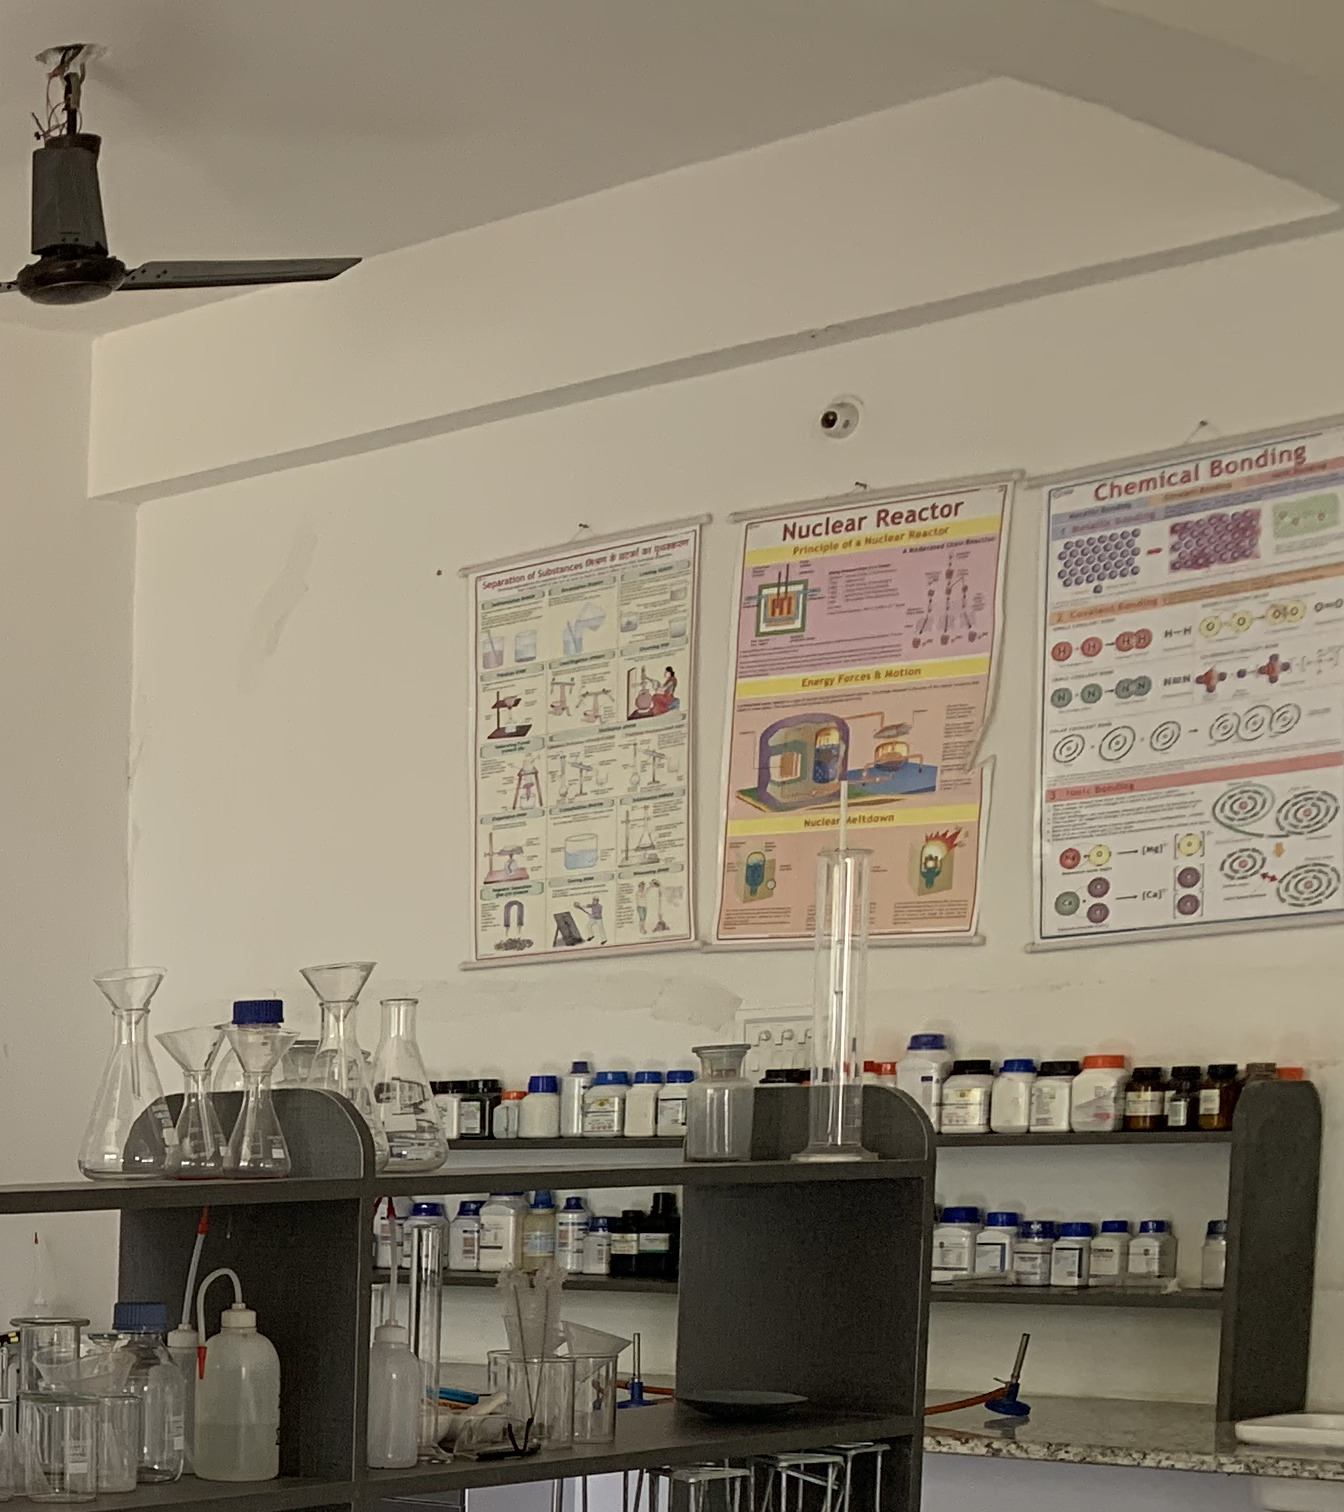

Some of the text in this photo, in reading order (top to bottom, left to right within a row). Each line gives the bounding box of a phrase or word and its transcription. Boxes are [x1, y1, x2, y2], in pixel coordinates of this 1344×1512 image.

[1094, 445, 1306, 501] Chemical Bonding
[1101, 502, 1131, 514] Bonding
[783, 501, 964, 541] Nuclear Reactor
[793, 540, 840, 555] Principle
[842, 538, 853, 550] of
[865, 532, 904, 545] Nuclear
[909, 526, 950, 539] Reactor
[909, 543, 944, 553] Moderated
[966, 536, 996, 545] Reaction
[483, 575, 525, 590] Separation
[527, 570, 535, 580] of
[537, 562, 583, 578] Substances
[1118, 598, 1157, 611] Bonding
[801, 676, 835, 689] Energy
[838, 671, 872, 684] Forces
[885, 667, 921, 679] Motion
[1095, 783, 1135, 794] Bonding
[804, 818, 840, 827] Nuclear
